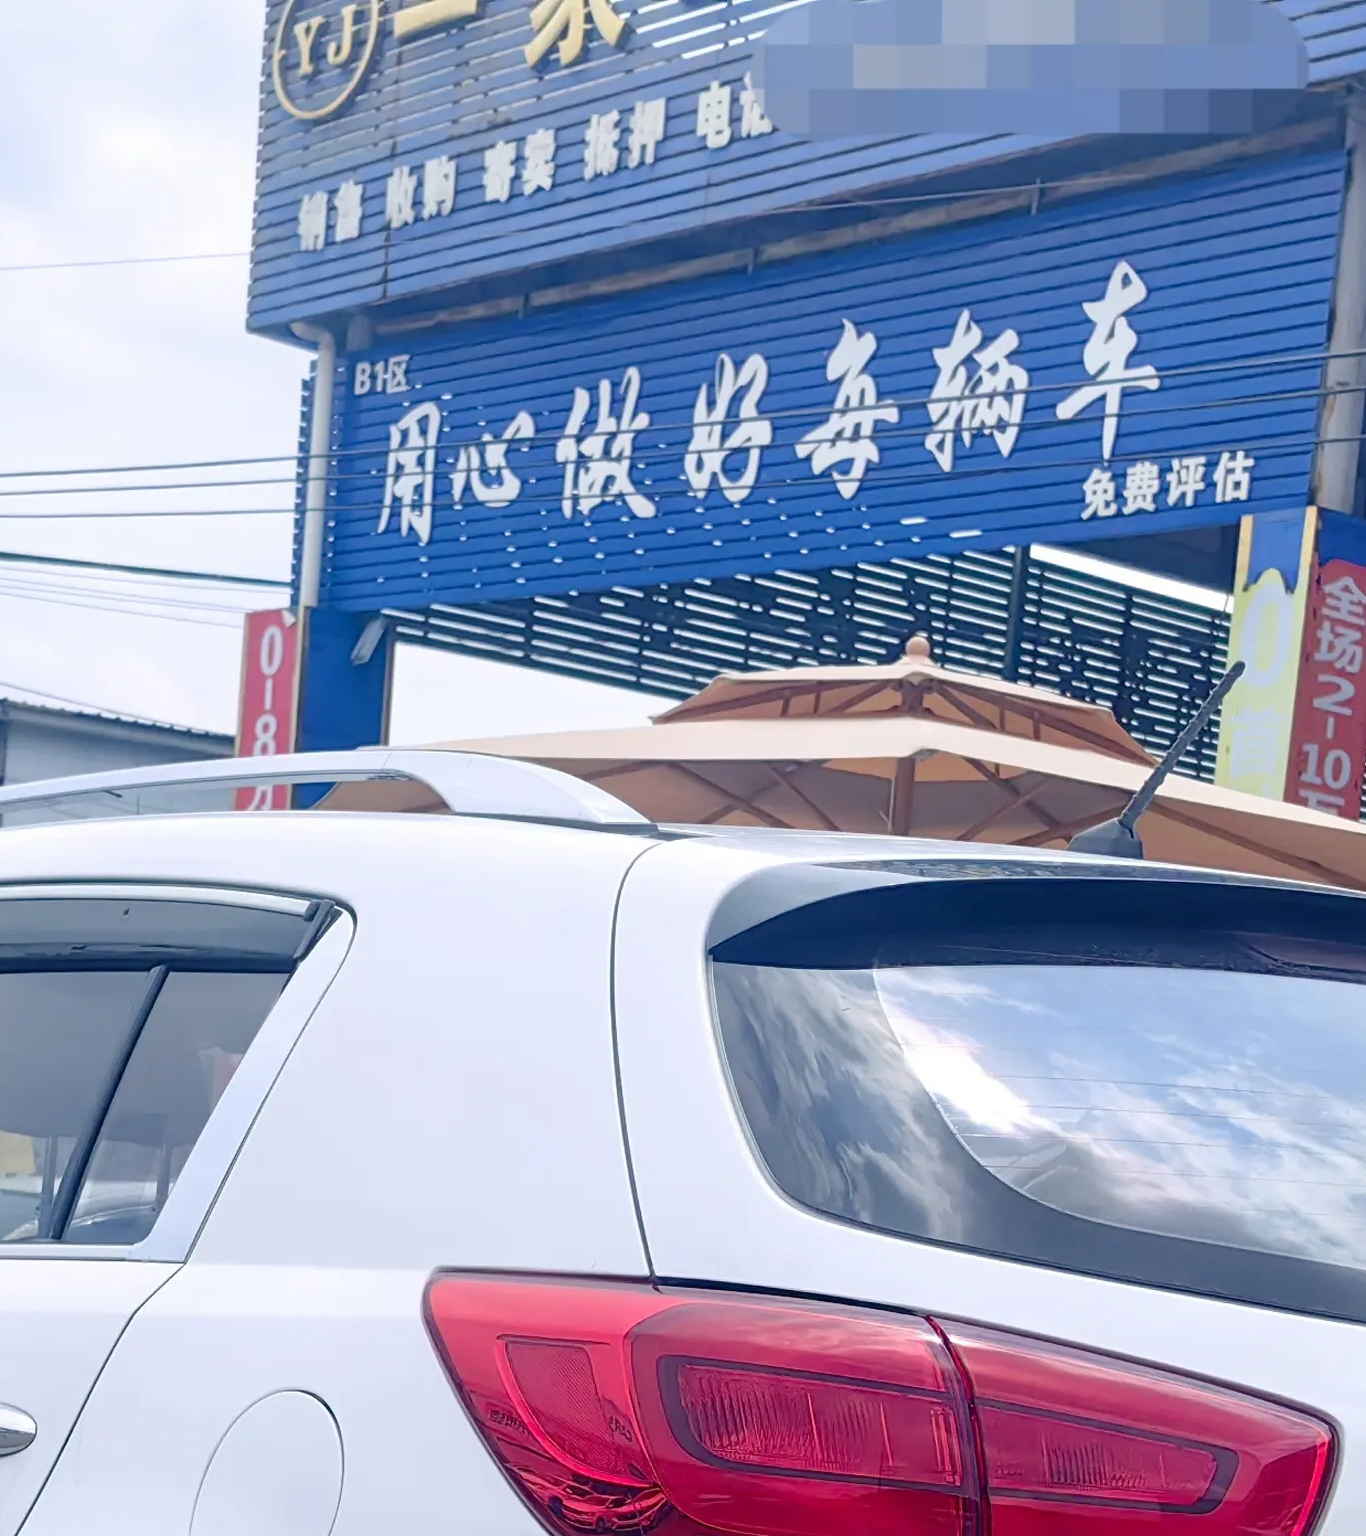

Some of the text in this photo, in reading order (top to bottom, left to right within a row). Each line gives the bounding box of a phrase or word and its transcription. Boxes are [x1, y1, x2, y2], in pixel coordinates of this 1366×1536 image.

[293, 4, 358, 76] YJ
[297, 178, 365, 251] 销售
[387, 154, 457, 229] 收购
[583, 97, 667, 182] 抵押
[354, 353, 412, 396] B1区
[377, 259, 1163, 546] 用心做好每辆车
[1080, 450, 1255, 521] 免费评估
[1229, 583, 1295, 799] 0首
